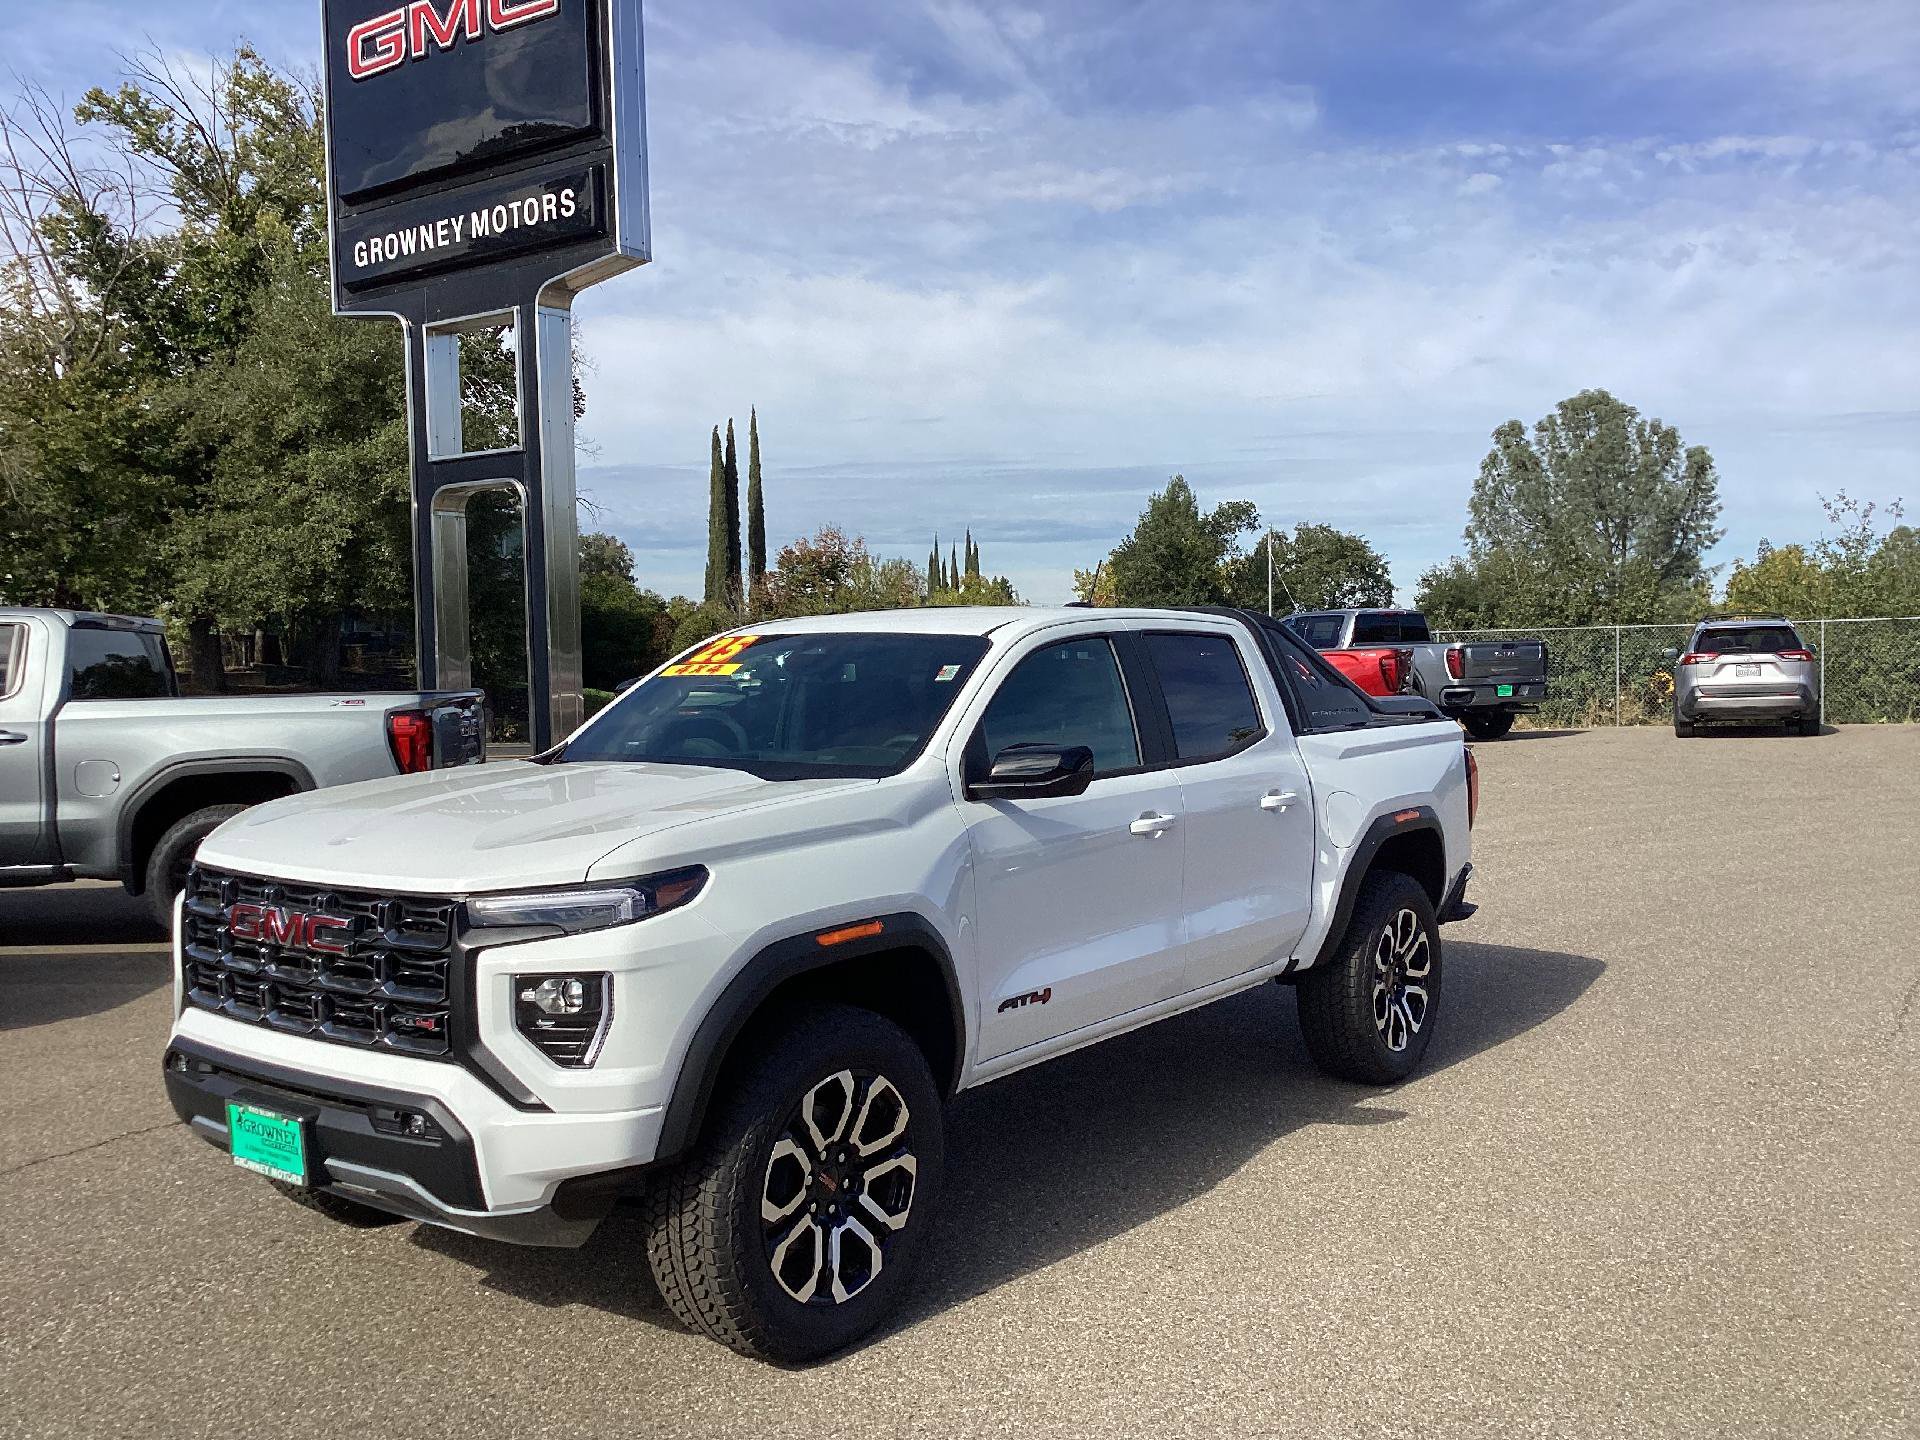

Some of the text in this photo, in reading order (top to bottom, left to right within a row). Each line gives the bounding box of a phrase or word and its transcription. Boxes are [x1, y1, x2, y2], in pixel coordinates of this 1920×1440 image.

[353, 188, 577, 268] GROWNEY MOTORS
[229, 901, 354, 955] GMC
[997, 987, 1052, 1014] AT4
[243, 1119, 297, 1146] GROWNEY
[233, 1156, 271, 1175] GROWNEY
[271, 1168, 303, 1186] MOTORS
